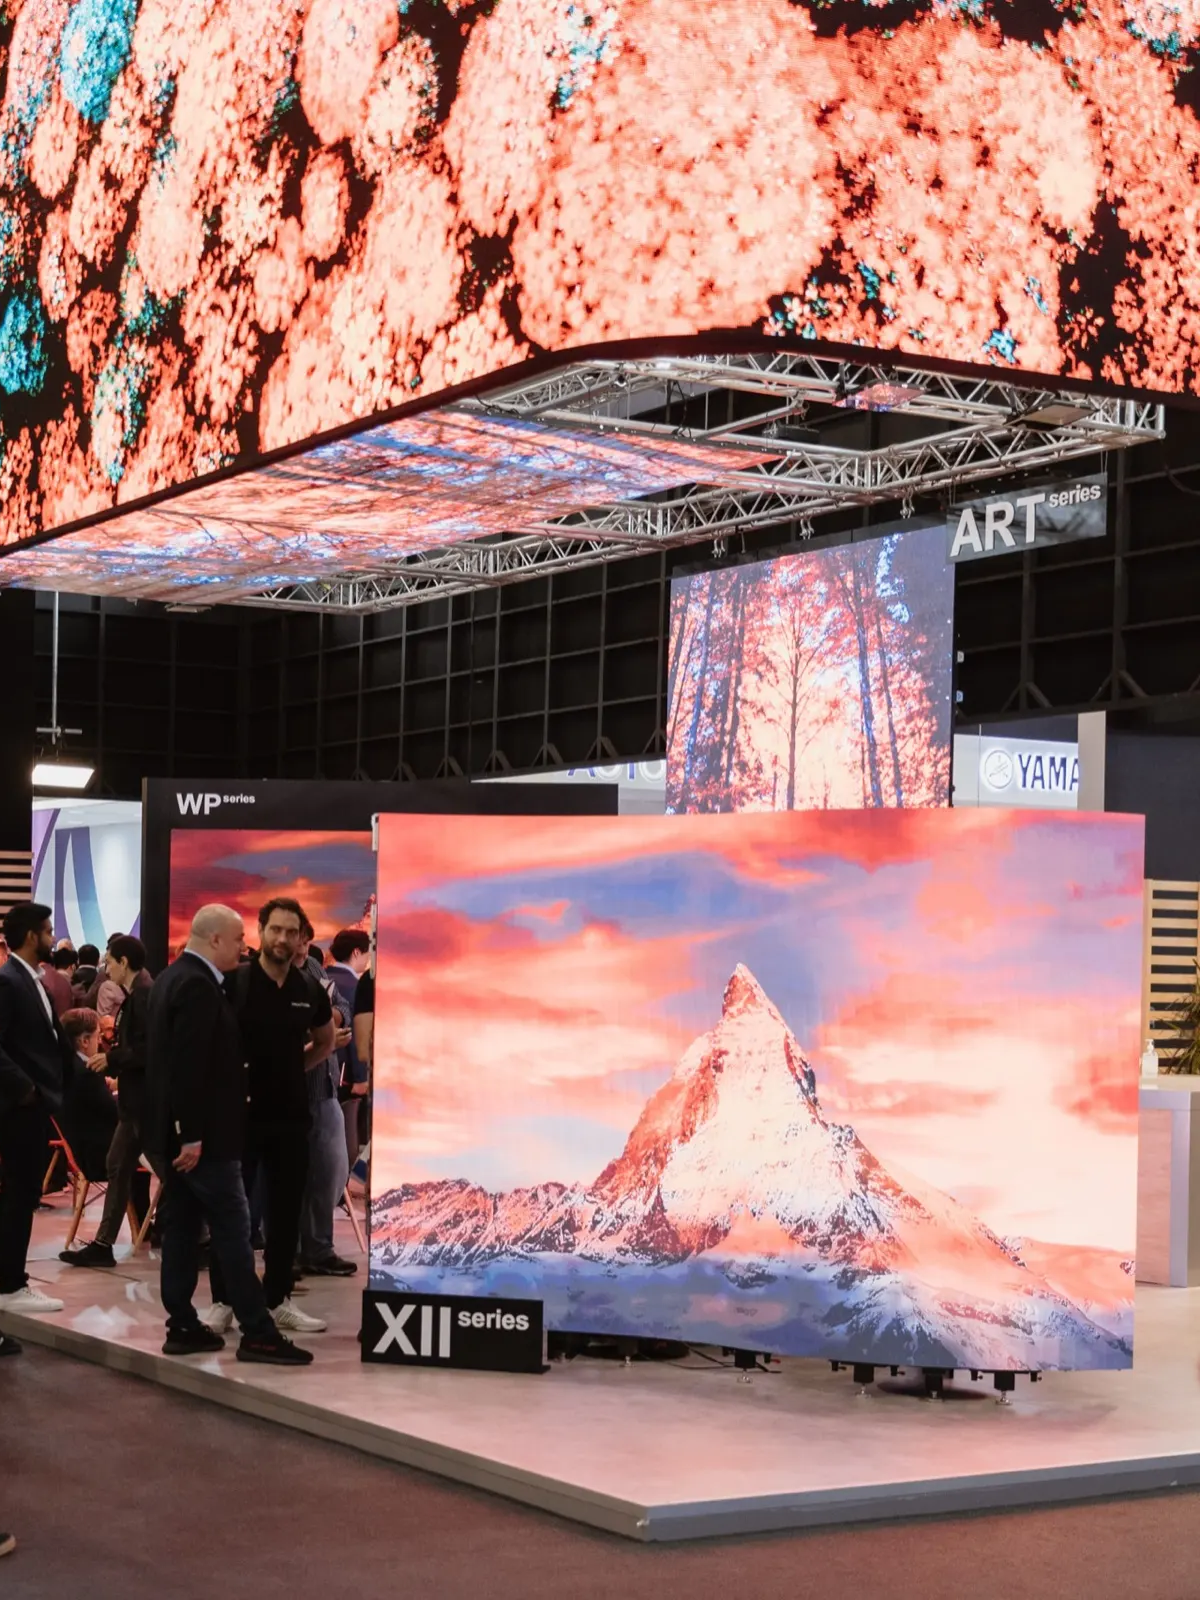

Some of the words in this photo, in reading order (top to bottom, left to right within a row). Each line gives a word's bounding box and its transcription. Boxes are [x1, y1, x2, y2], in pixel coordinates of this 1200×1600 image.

[950, 493, 1046, 557] ART
[1049, 484, 1101, 508] series
[1018, 754, 1079, 791] YAMA
[176, 793, 222, 816] WP
[223, 793, 256, 804] series
[372, 1302, 452, 1358] XII
[457, 1309, 530, 1331] series
